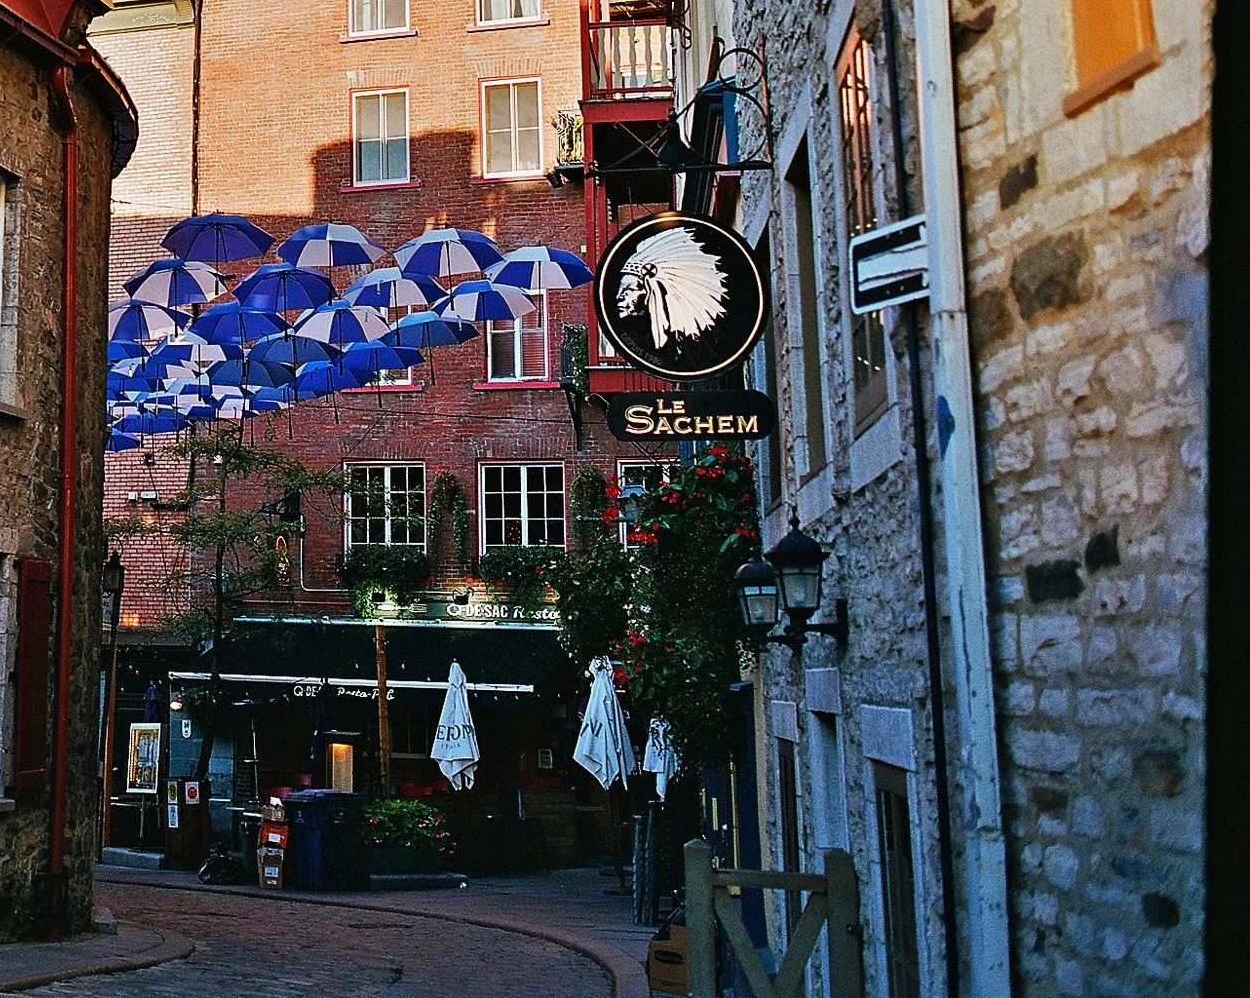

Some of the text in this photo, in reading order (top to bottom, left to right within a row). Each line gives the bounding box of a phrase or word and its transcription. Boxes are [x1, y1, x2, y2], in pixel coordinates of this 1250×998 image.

[620, 332, 644, 356] DEPUIS
[656, 399, 685, 413] LE
[625, 405, 759, 434] SACHEM
